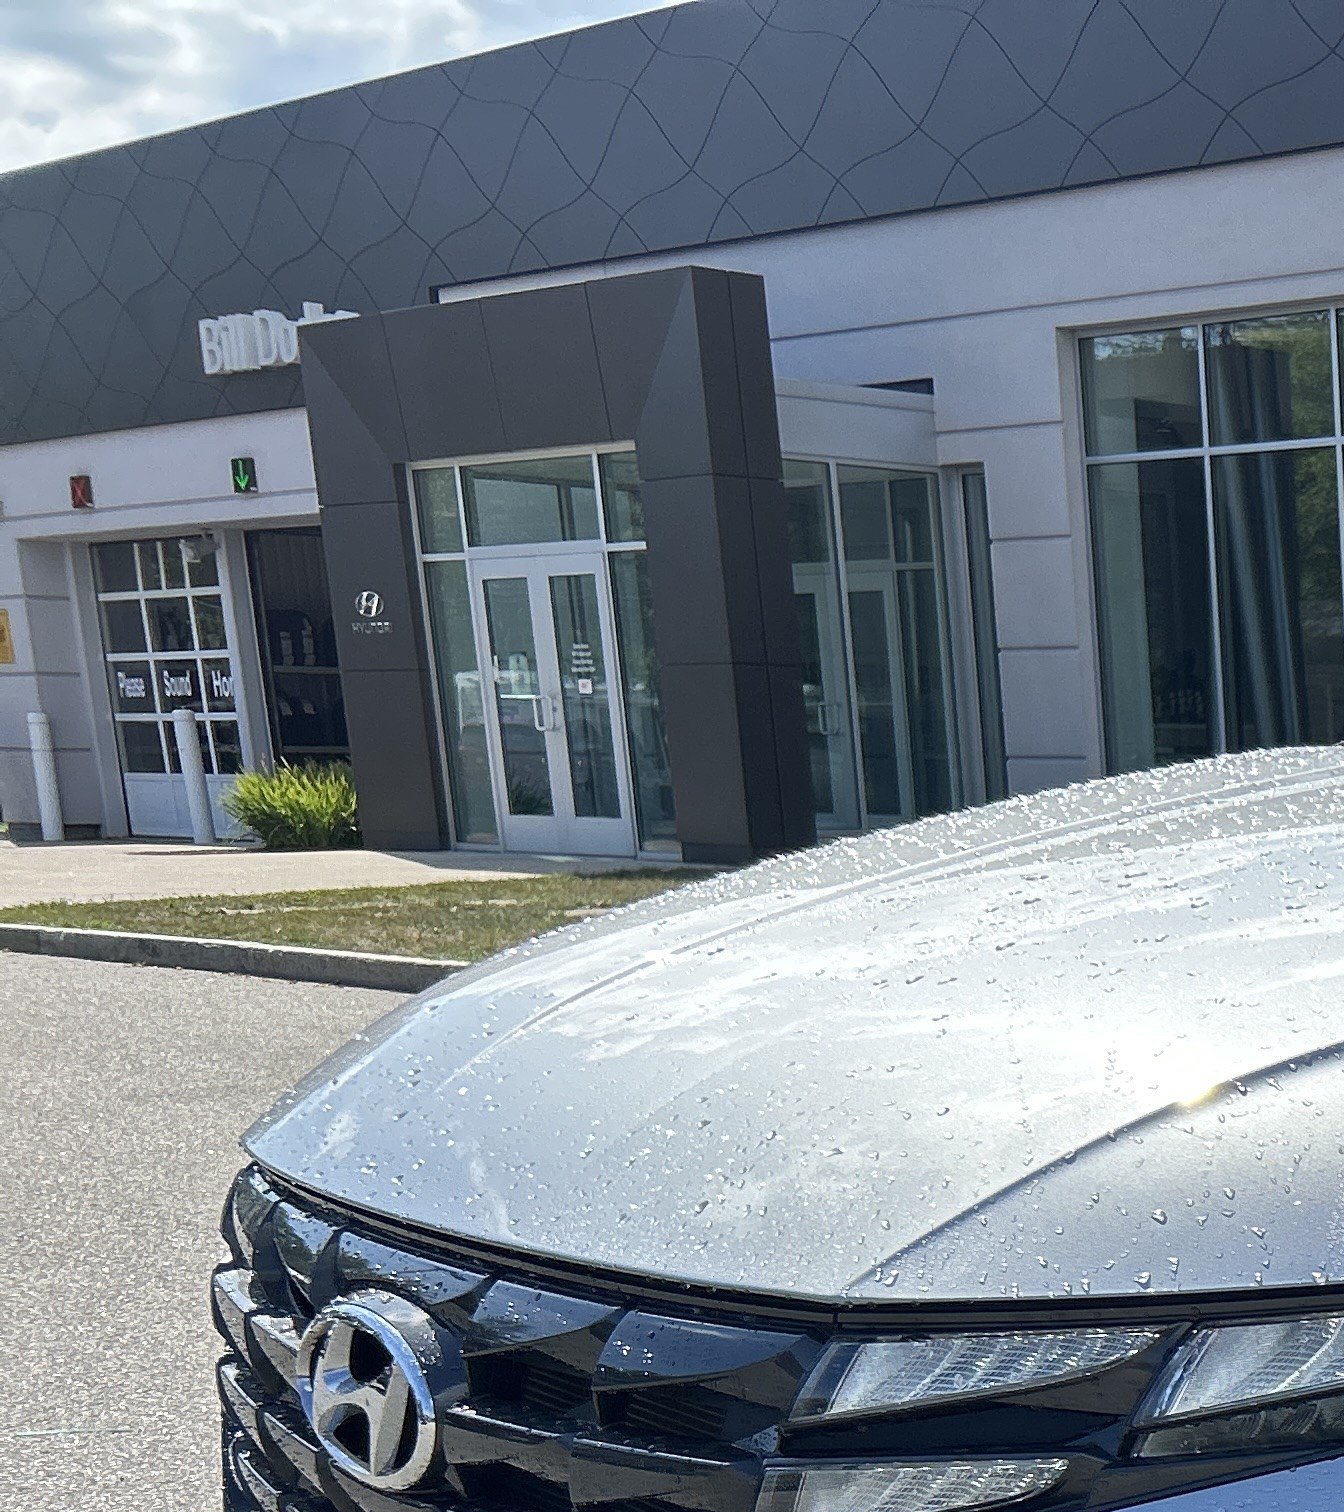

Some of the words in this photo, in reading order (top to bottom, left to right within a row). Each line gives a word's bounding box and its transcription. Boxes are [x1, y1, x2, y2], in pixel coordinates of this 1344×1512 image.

[198, 313, 261, 375] Bill
[117, 671, 146, 698] Please
[163, 670, 193, 697] Sound
